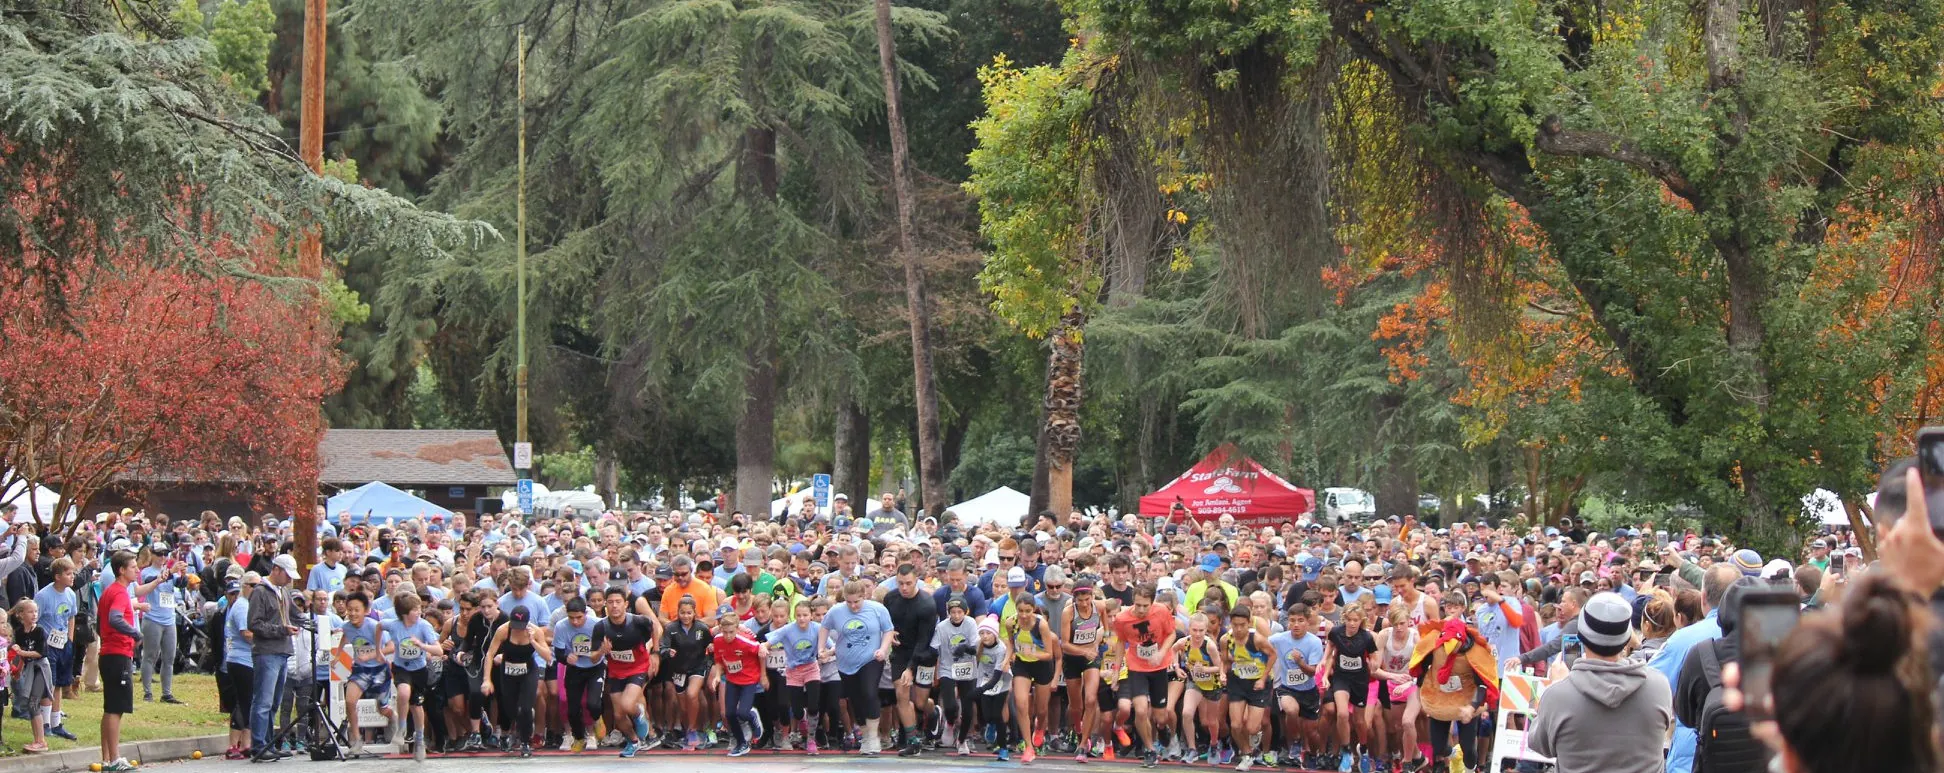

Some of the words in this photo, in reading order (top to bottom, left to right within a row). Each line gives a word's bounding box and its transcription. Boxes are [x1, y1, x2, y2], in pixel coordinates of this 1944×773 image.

[1075, 632, 1095, 640] 1535
[768, 655, 784, 664] 714
[1342, 659, 1360, 667] 206
[506, 667, 526, 675] 1229
[955, 667, 971, 677] 692
[1288, 673, 1305, 682] 690
